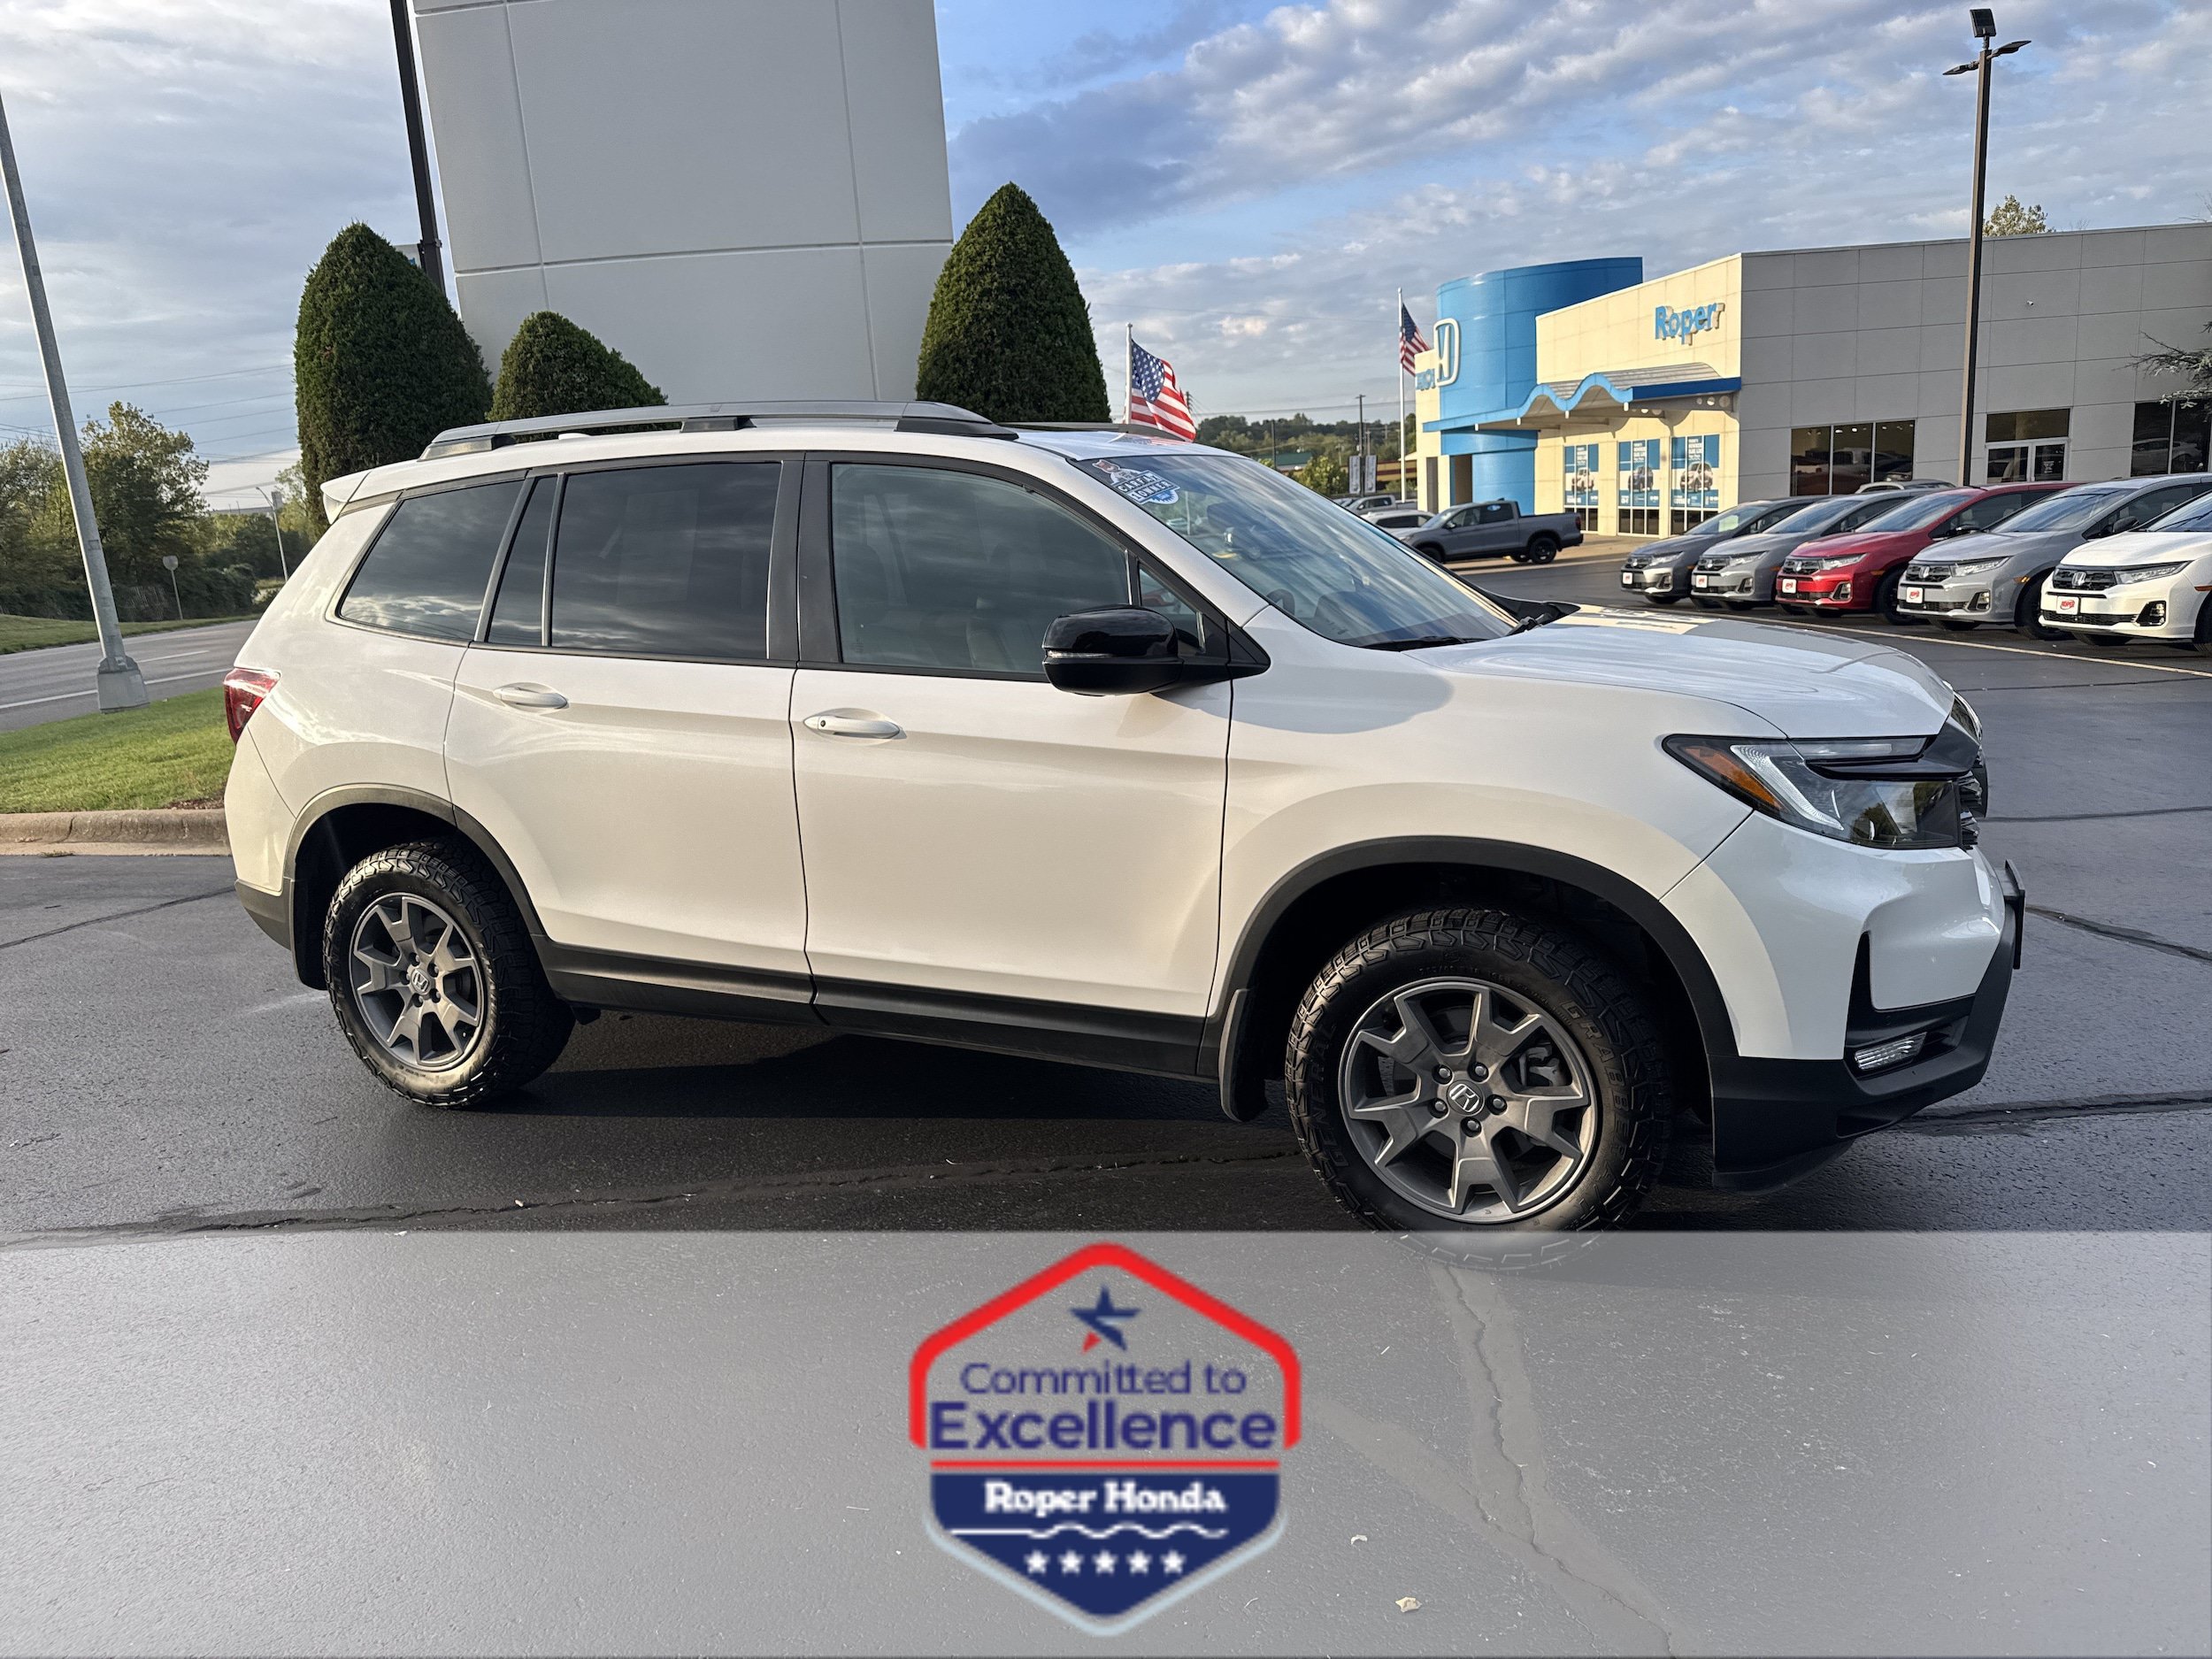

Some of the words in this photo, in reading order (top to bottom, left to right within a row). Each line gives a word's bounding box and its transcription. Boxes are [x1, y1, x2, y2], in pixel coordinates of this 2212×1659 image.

[1655, 303, 1723, 345] Roper
[1118, 473, 1159, 492] CARFAX
[1561, 1000, 1630, 1161] GRABBER
